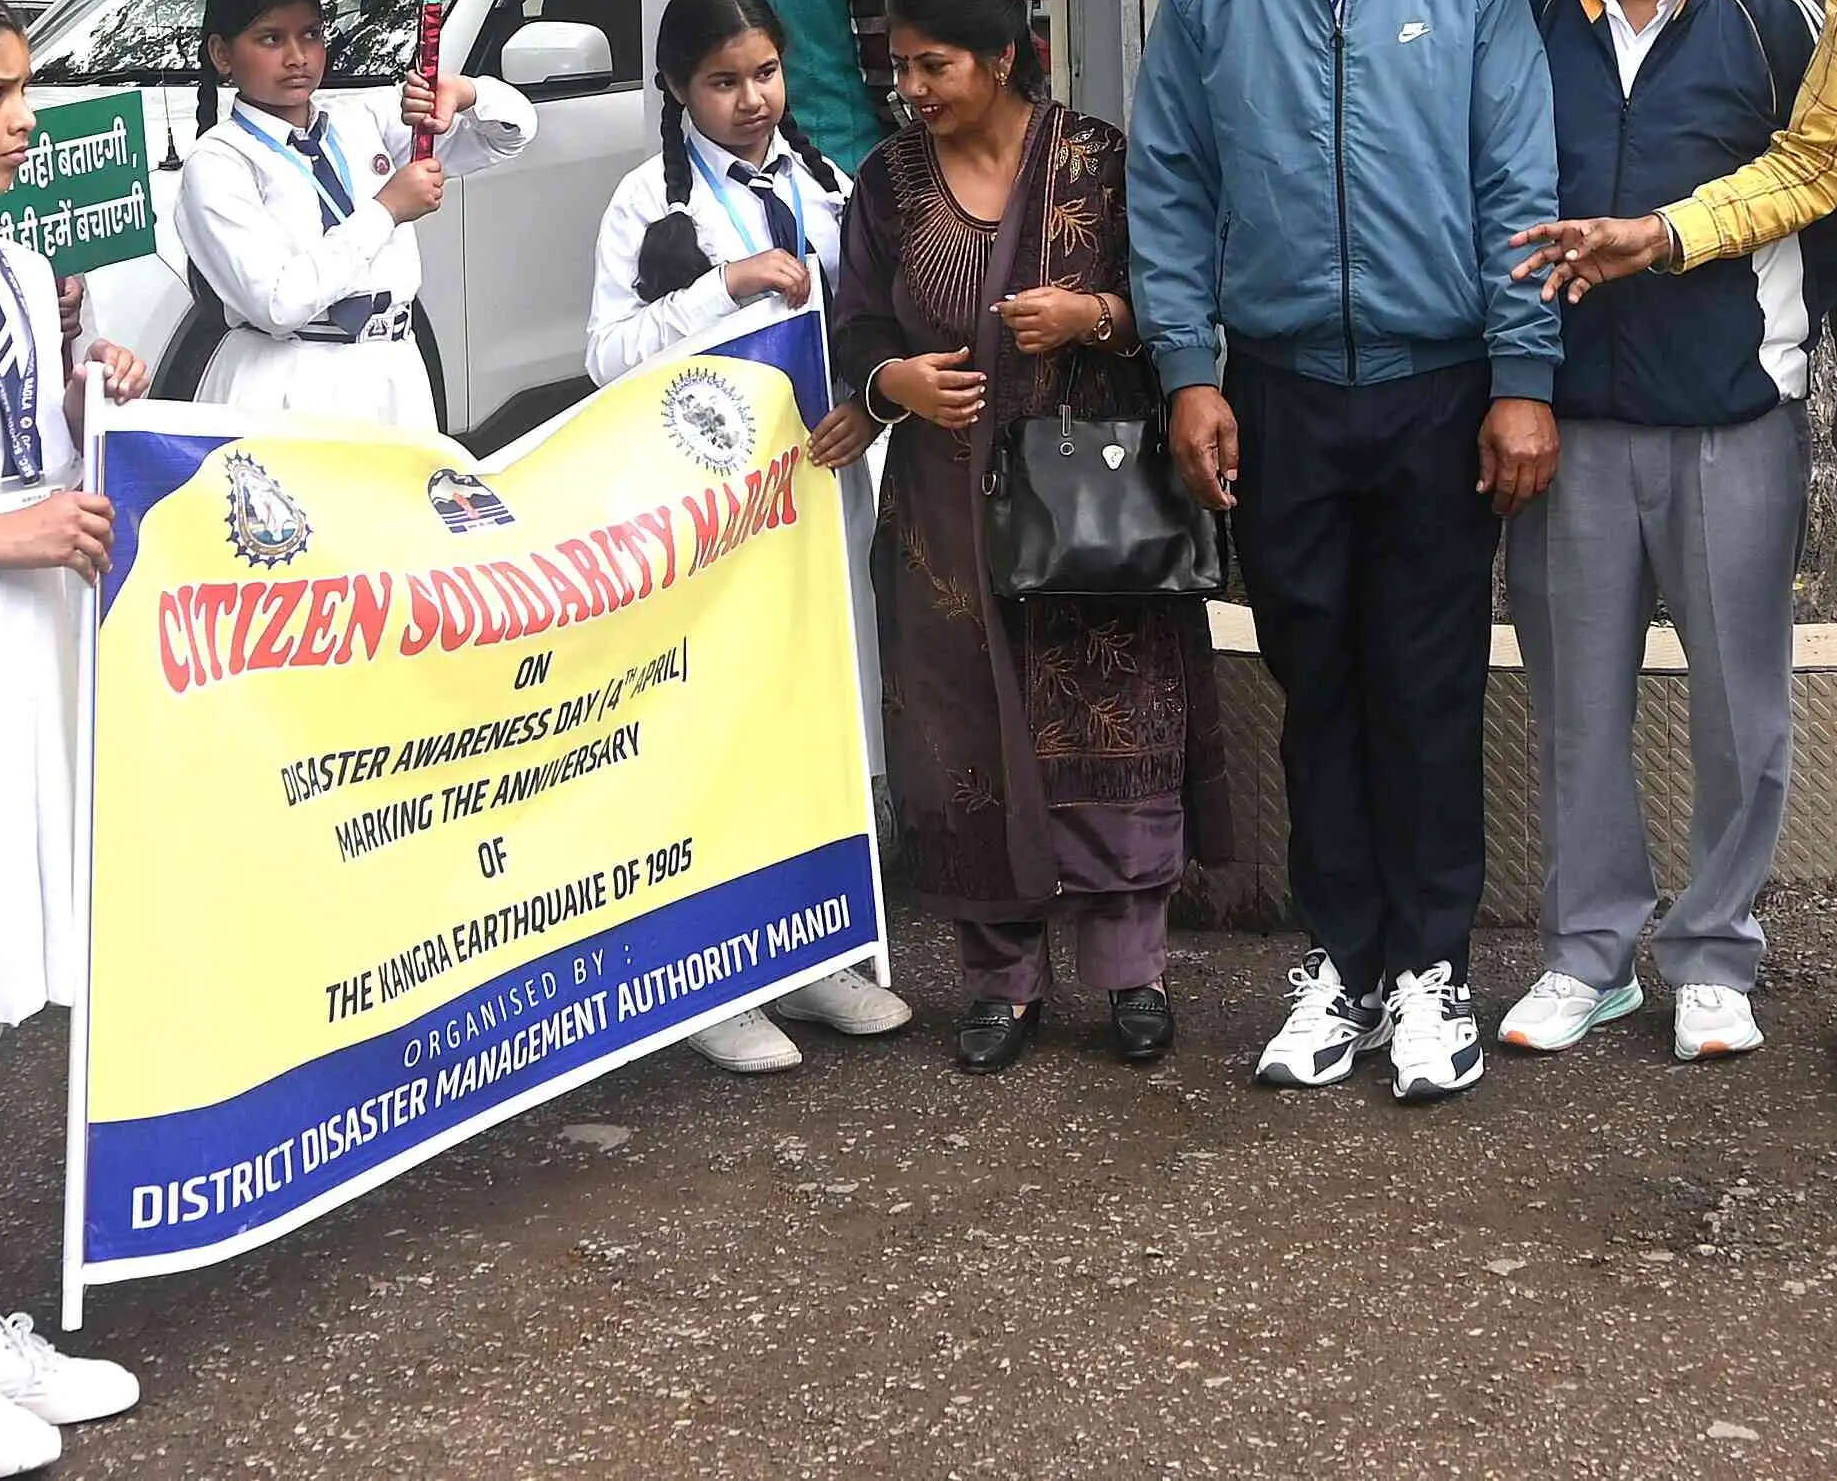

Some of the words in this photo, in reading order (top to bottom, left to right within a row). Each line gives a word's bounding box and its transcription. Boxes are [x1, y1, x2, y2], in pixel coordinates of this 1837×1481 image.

[38, 199, 74, 257] हमें
[72, 180, 147, 243] बचाएगी
[158, 572, 393, 694] CITIZEN
[399, 505, 676, 657] SOLIDARITY
[682, 446, 801, 577] MARCH
[513, 650, 553, 691] ON
[280, 745, 391, 807] DISASTER
[390, 707, 550, 775] AWARENESS
[552, 689, 599, 736] DAY
[335, 793, 434, 863] MARKING
[441, 778, 491, 824] THE
[490, 721, 641, 809] ANNIVERSARY
[477, 835, 509, 879] OF
[325, 970, 375, 1024] THE
[377, 933, 453, 1004] KANGRA
[452, 871, 607, 963] EARTHQUAKE
[612, 859, 641, 901] OF
[645, 837, 694, 887] 1905
[130, 1137, 295, 1231] DISTRICT
[300, 1076, 428, 1175] DISASTER
[434, 990, 609, 1110] MANAGEMENT
[616, 927, 762, 1024] AUTHORITY
[766, 893, 852, 961] MANDI
[402, 969, 558, 1069] ORGANISED
[572, 947, 606, 986] BY
